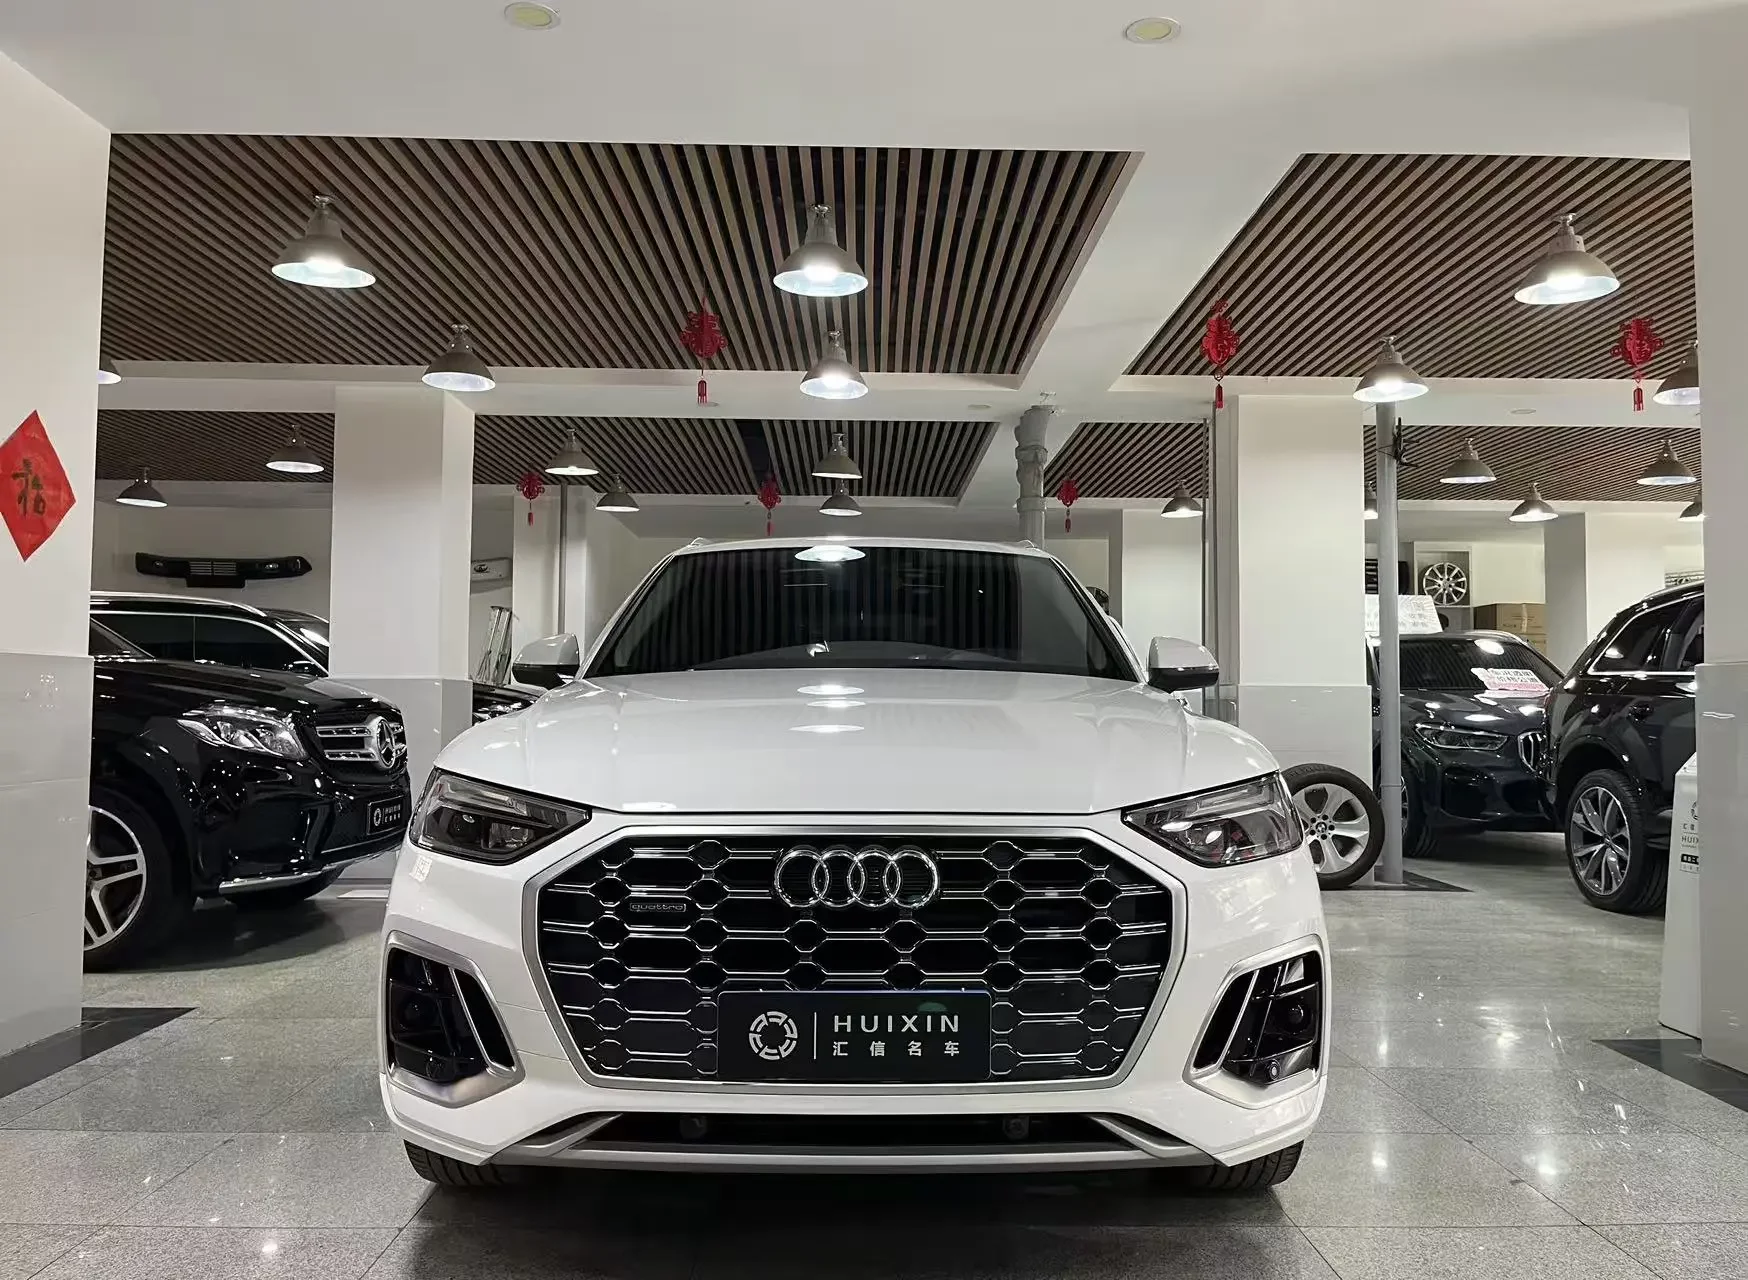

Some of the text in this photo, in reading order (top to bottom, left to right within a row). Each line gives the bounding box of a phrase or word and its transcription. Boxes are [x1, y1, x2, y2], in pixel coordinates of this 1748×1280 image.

[834, 1015, 959, 1033] HUIXIN
[832, 1040, 960, 1056] 汇信名车
